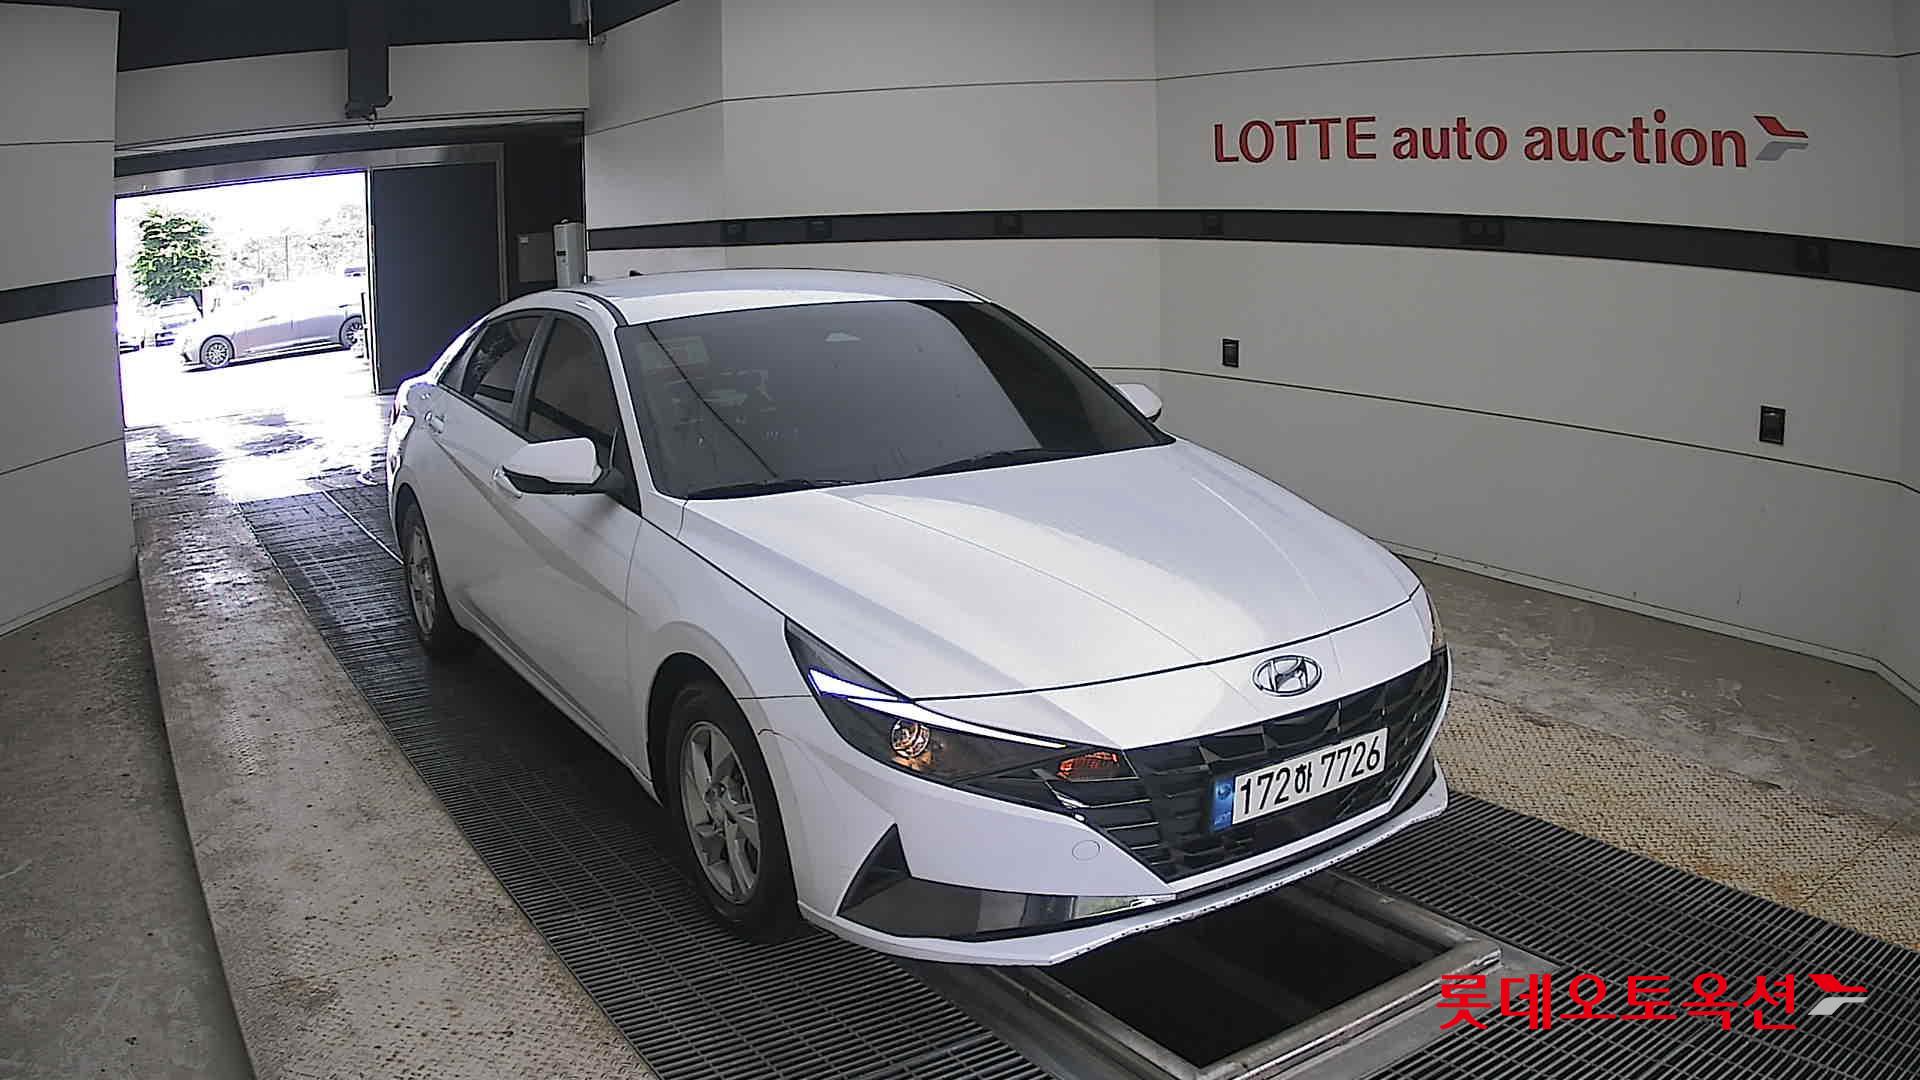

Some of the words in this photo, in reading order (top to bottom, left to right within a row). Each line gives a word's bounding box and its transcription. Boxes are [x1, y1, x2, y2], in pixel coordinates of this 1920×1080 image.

[1213, 116, 1377, 163] LOTTE
[1392, 116, 1508, 161] auto
[1523, 109, 1748, 167] auction
[1239, 761, 1313, 815] 172하
[1320, 736, 1381, 788] 7726
